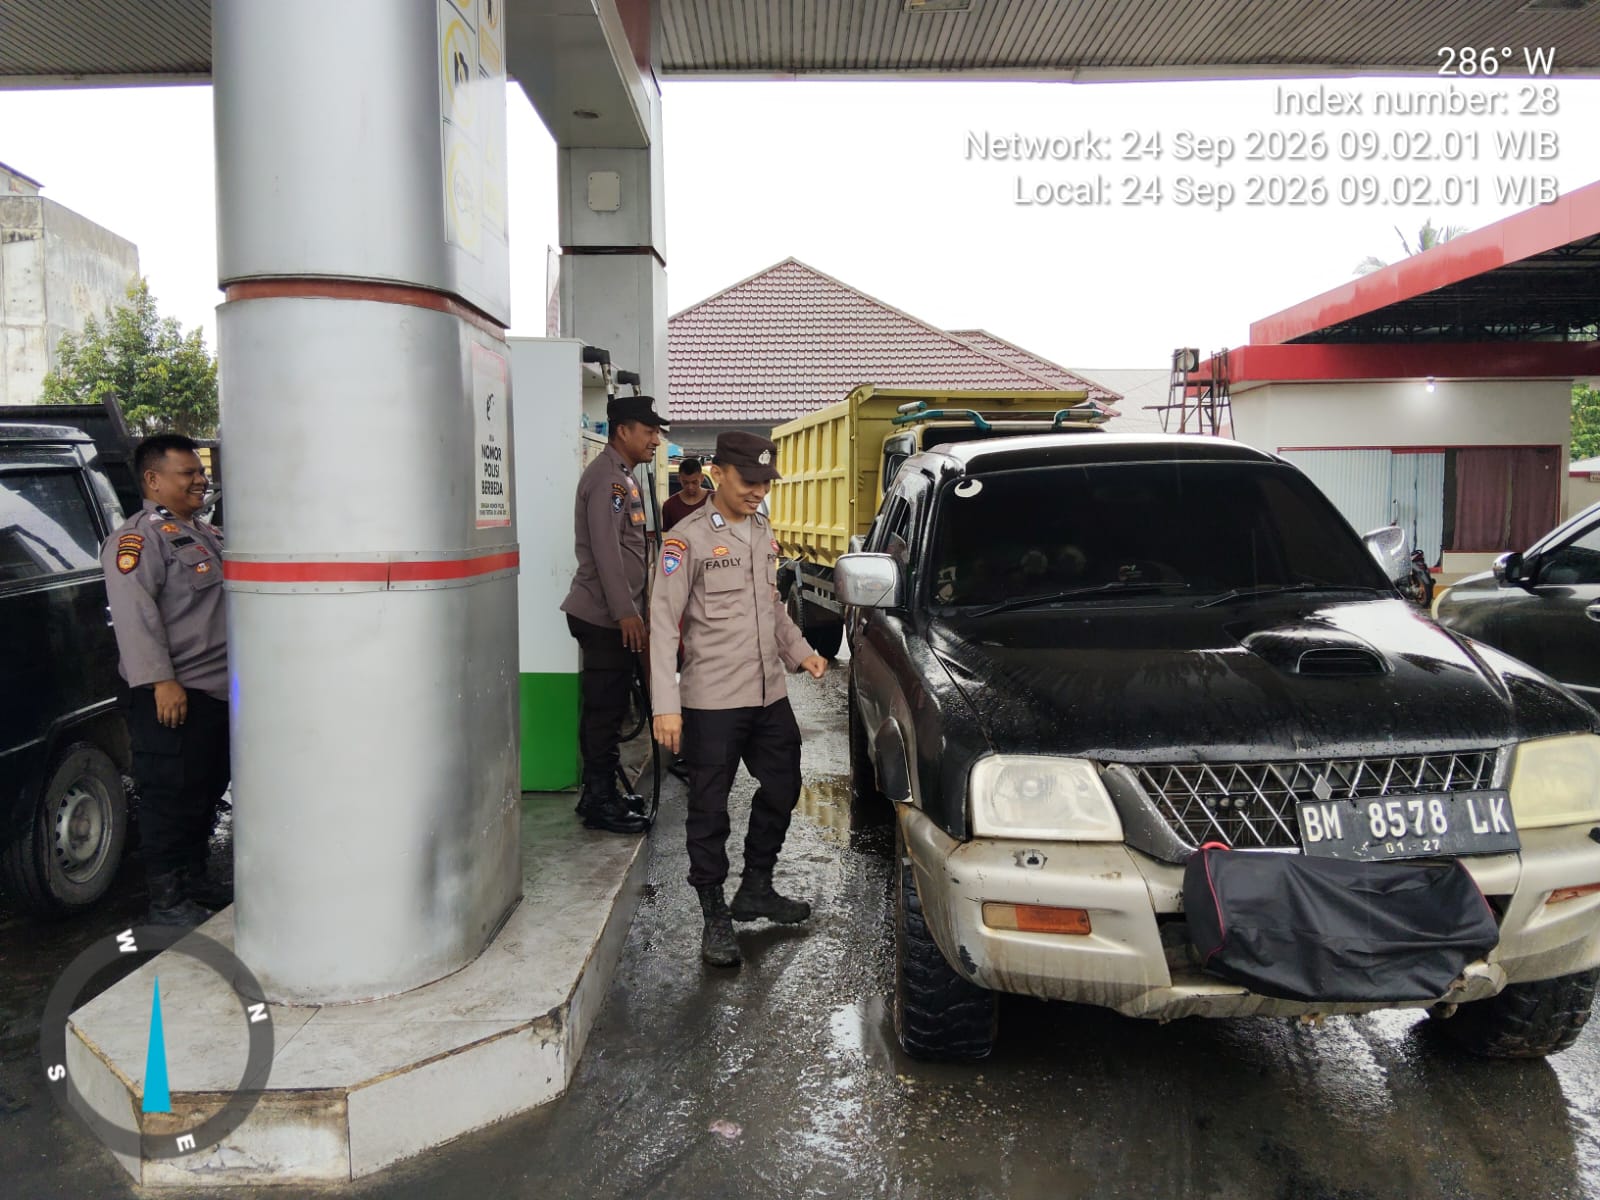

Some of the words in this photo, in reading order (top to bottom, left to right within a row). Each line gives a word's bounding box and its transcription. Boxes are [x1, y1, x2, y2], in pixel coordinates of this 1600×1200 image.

[481, 444, 502, 461] NOMOR
[484, 462, 500, 478] POLISI
[481, 480, 504, 496] BERBEDA
[705, 557, 742, 570] FADLY
[1302, 804, 1343, 843] BM
[1368, 799, 1448, 838] 8578
[1467, 797, 1511, 834] LK
